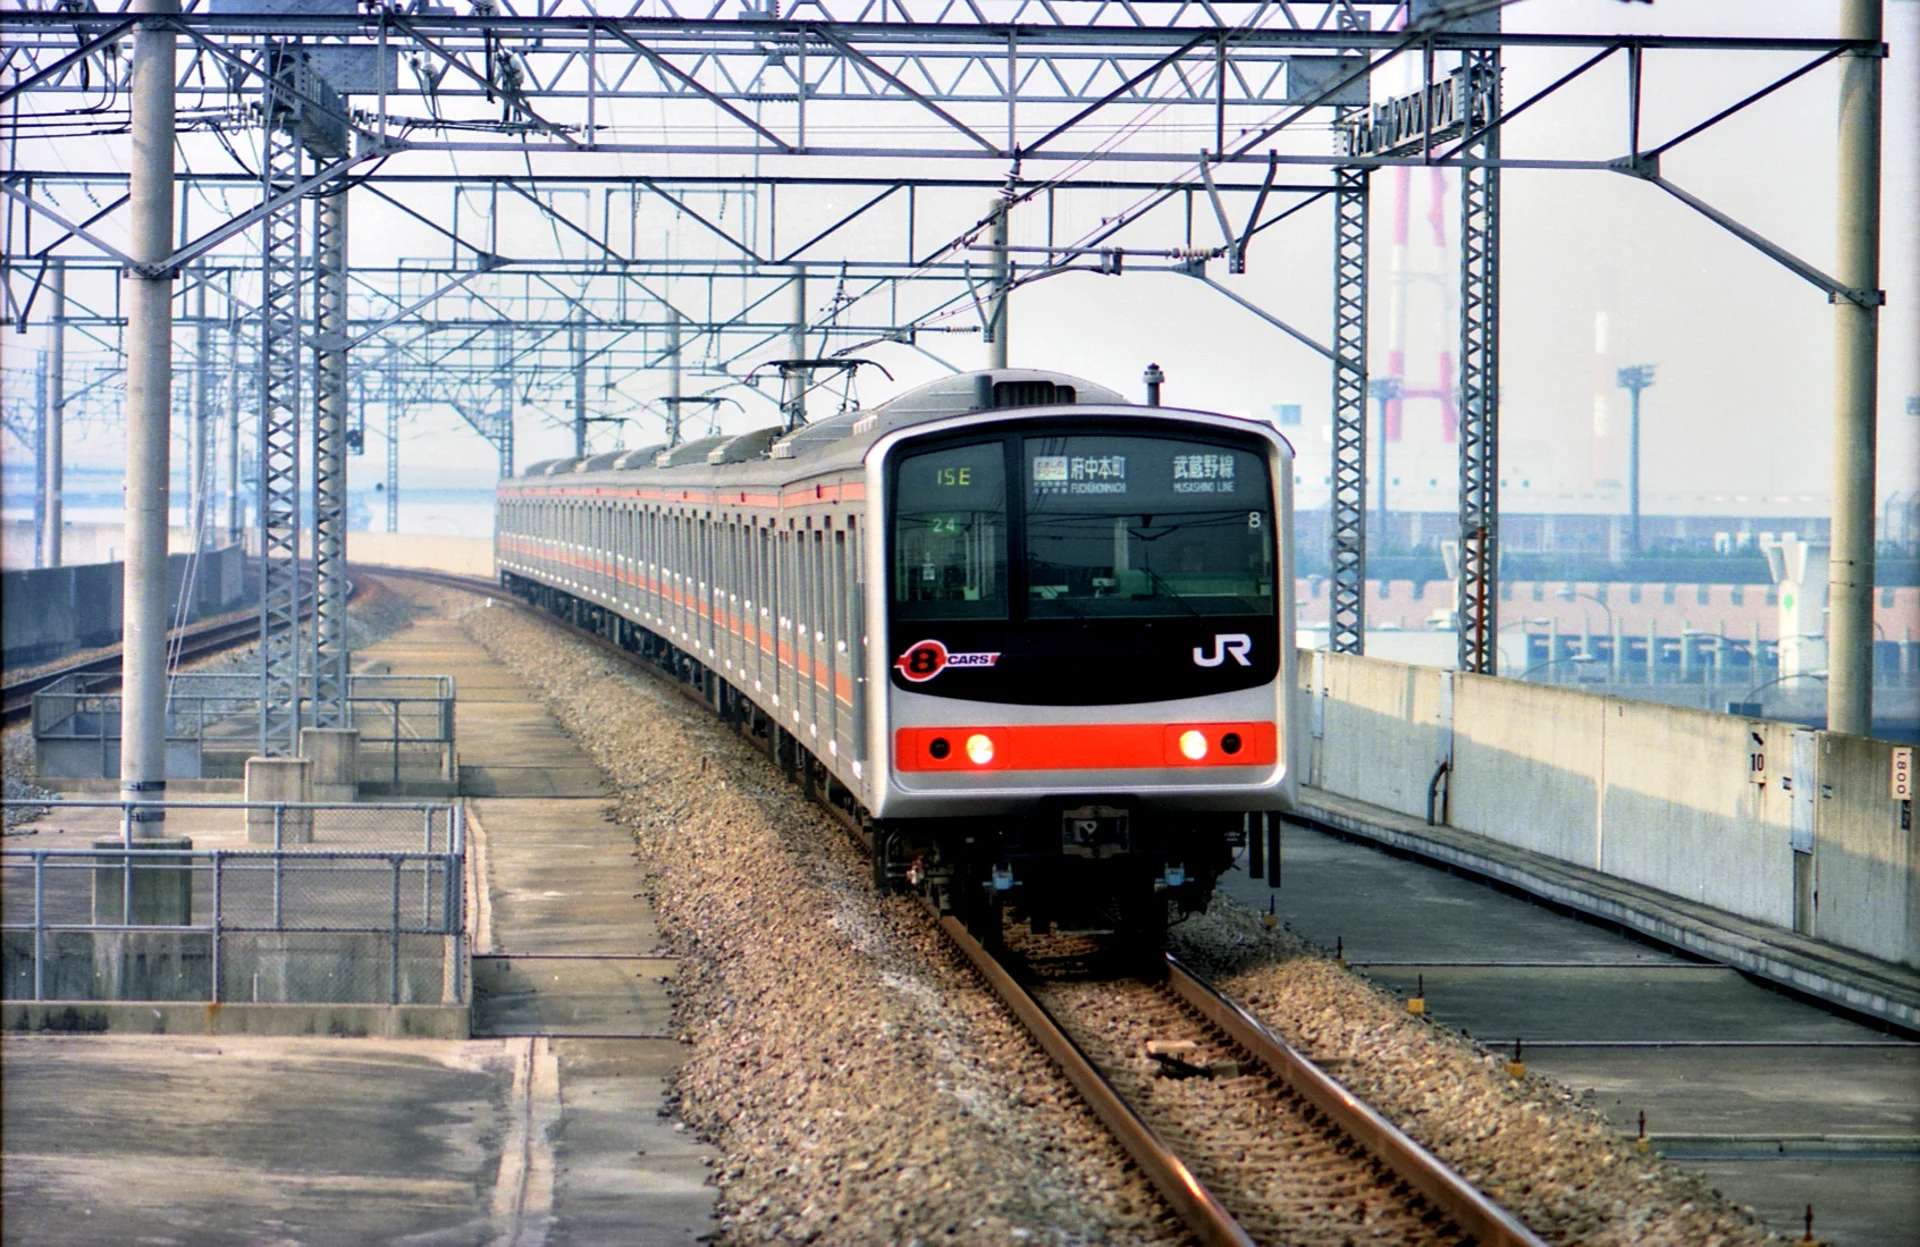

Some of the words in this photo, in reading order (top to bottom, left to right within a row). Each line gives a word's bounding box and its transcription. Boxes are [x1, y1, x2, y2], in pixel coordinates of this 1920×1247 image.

[1071, 455, 1126, 480] 府中本町
[1173, 455, 1235, 479] 武蔵野線
[932, 518, 955, 533] 24
[1249, 511, 1261, 528] 8
[909, 648, 938, 673] 8
[947, 655, 989, 665] CARS
[1193, 633, 1252, 667] JR
[1750, 753, 1765, 772] 10
